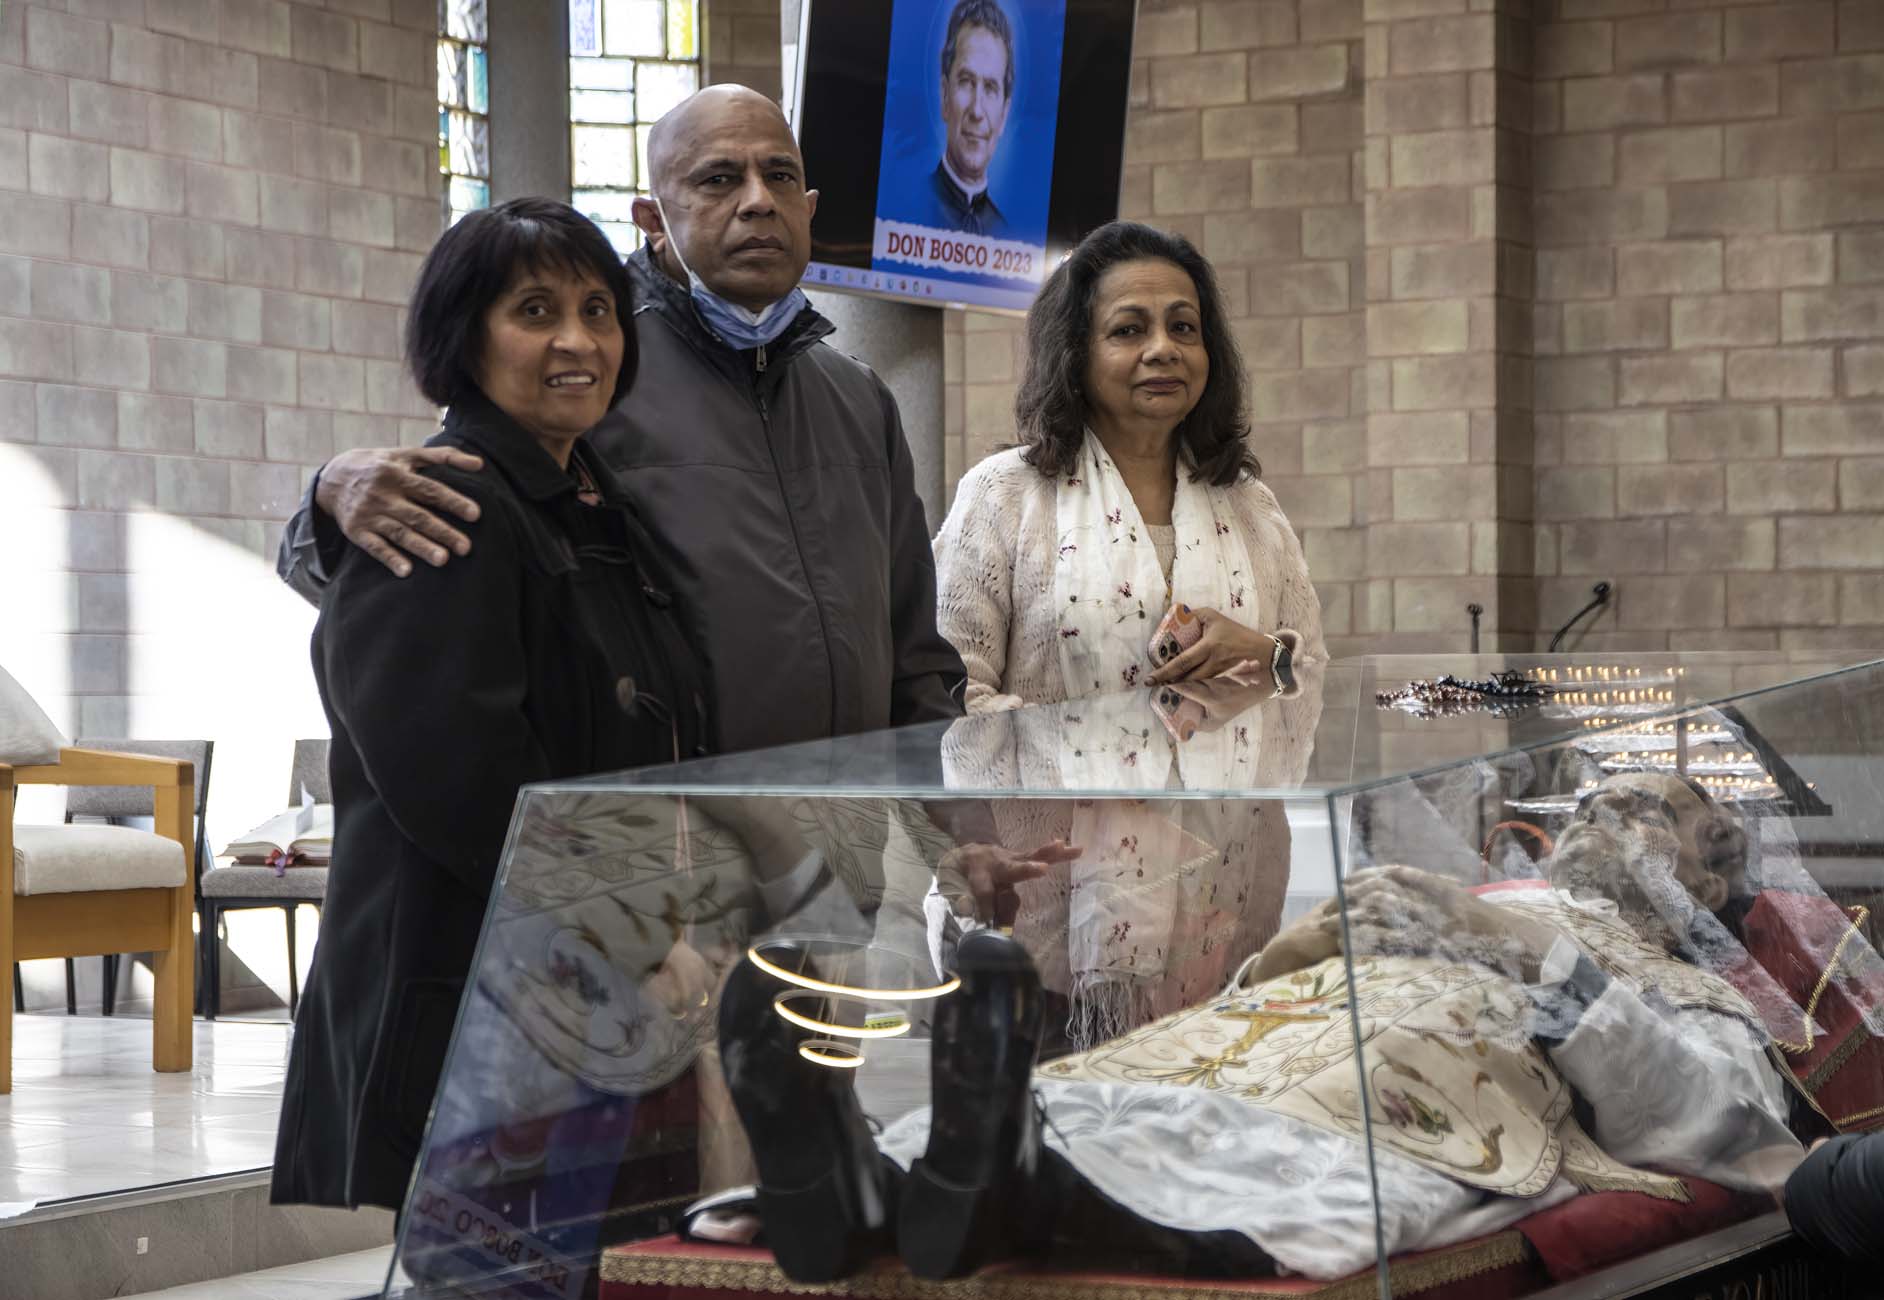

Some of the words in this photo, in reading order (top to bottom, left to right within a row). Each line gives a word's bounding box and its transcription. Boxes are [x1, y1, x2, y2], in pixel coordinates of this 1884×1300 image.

[887, 232, 926, 257] DON
[930, 239, 988, 267] BOSCO
[993, 249, 1032, 273] 2023
